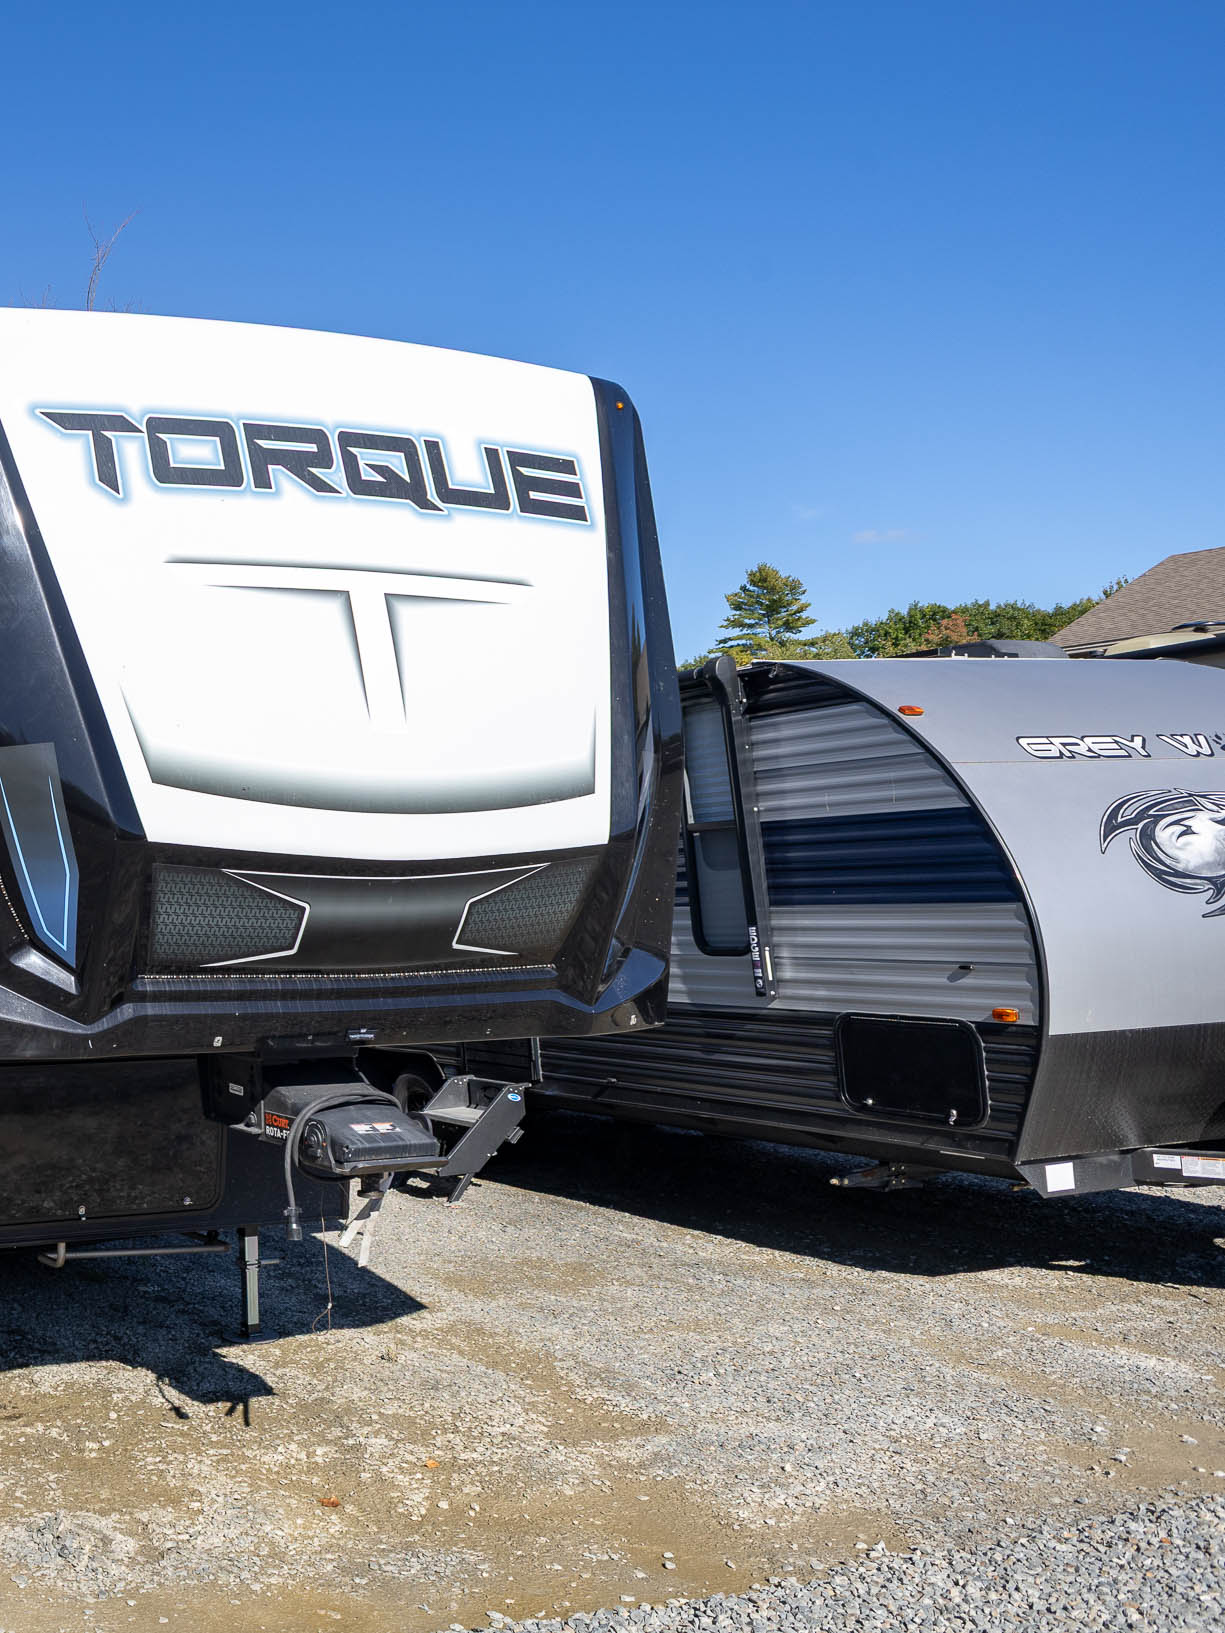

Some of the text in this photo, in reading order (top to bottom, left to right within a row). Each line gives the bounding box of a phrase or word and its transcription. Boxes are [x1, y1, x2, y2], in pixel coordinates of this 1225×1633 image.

[36, 409, 590, 524] TORQUE
[1015, 734, 1152, 760] GREY
[749, 927, 760, 960] EDGE
[266, 1126, 290, 1139] ROTA-F
